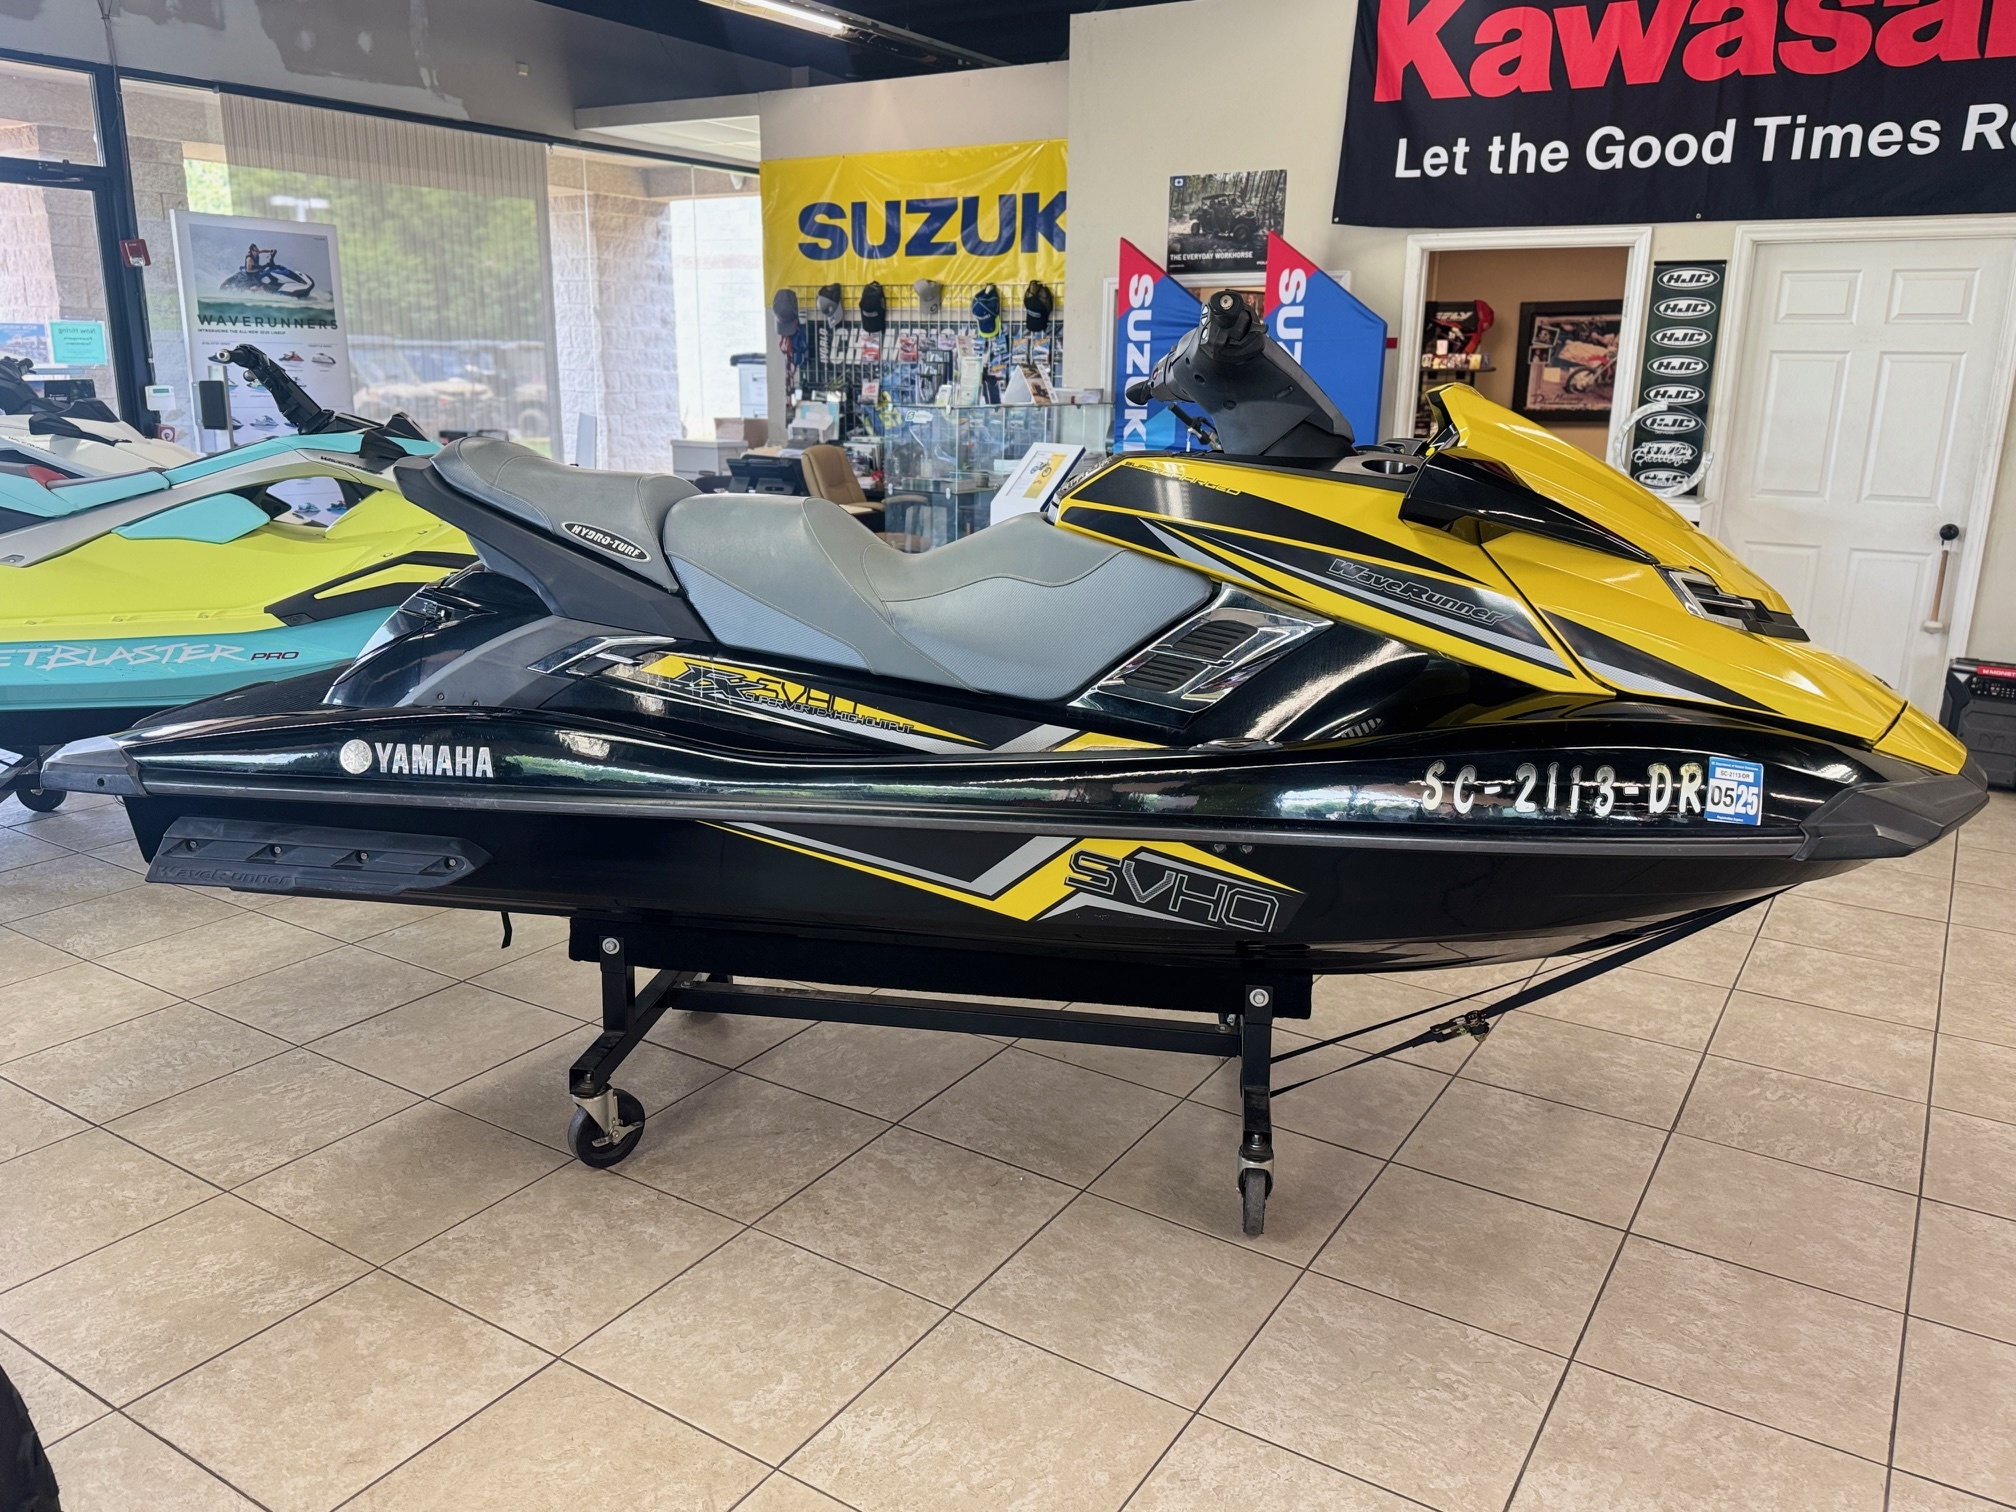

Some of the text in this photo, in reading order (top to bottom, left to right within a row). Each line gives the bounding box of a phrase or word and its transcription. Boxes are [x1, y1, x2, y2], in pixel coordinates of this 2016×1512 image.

[1395, 103, 2016, 178] Let the Good Times R
[798, 190, 1067, 261] SUZUK
[1182, 252, 1214, 260] EVERYDAY
[1214, 251, 1254, 260] WORKHORSE
[1666, 274, 1711, 284] HJC
[1663, 303, 1707, 312] HJC
[197, 314, 338, 330] WAVERUNNERS
[1660, 332, 1704, 342] HJC
[1656, 361, 1700, 370] HJC
[1652, 390, 1696, 399] HJC
[1649, 418, 1693, 428] HJC
[571, 524, 641, 557] HYDRO-TURF
[1326, 558, 1514, 626] WaveRunner
[0, 643, 300, 671] ETBLASTER PRO
[1990, 669, 2016, 678] MONST
[744, 692, 914, 734] SUPER VORTEX HIGH OUTPUT
[374, 742, 495, 778] YAMAHA
[1711, 785, 1759, 816] 05 25
[154, 865, 292, 886] WaveRunner
[1064, 849, 1279, 932] SVHO
